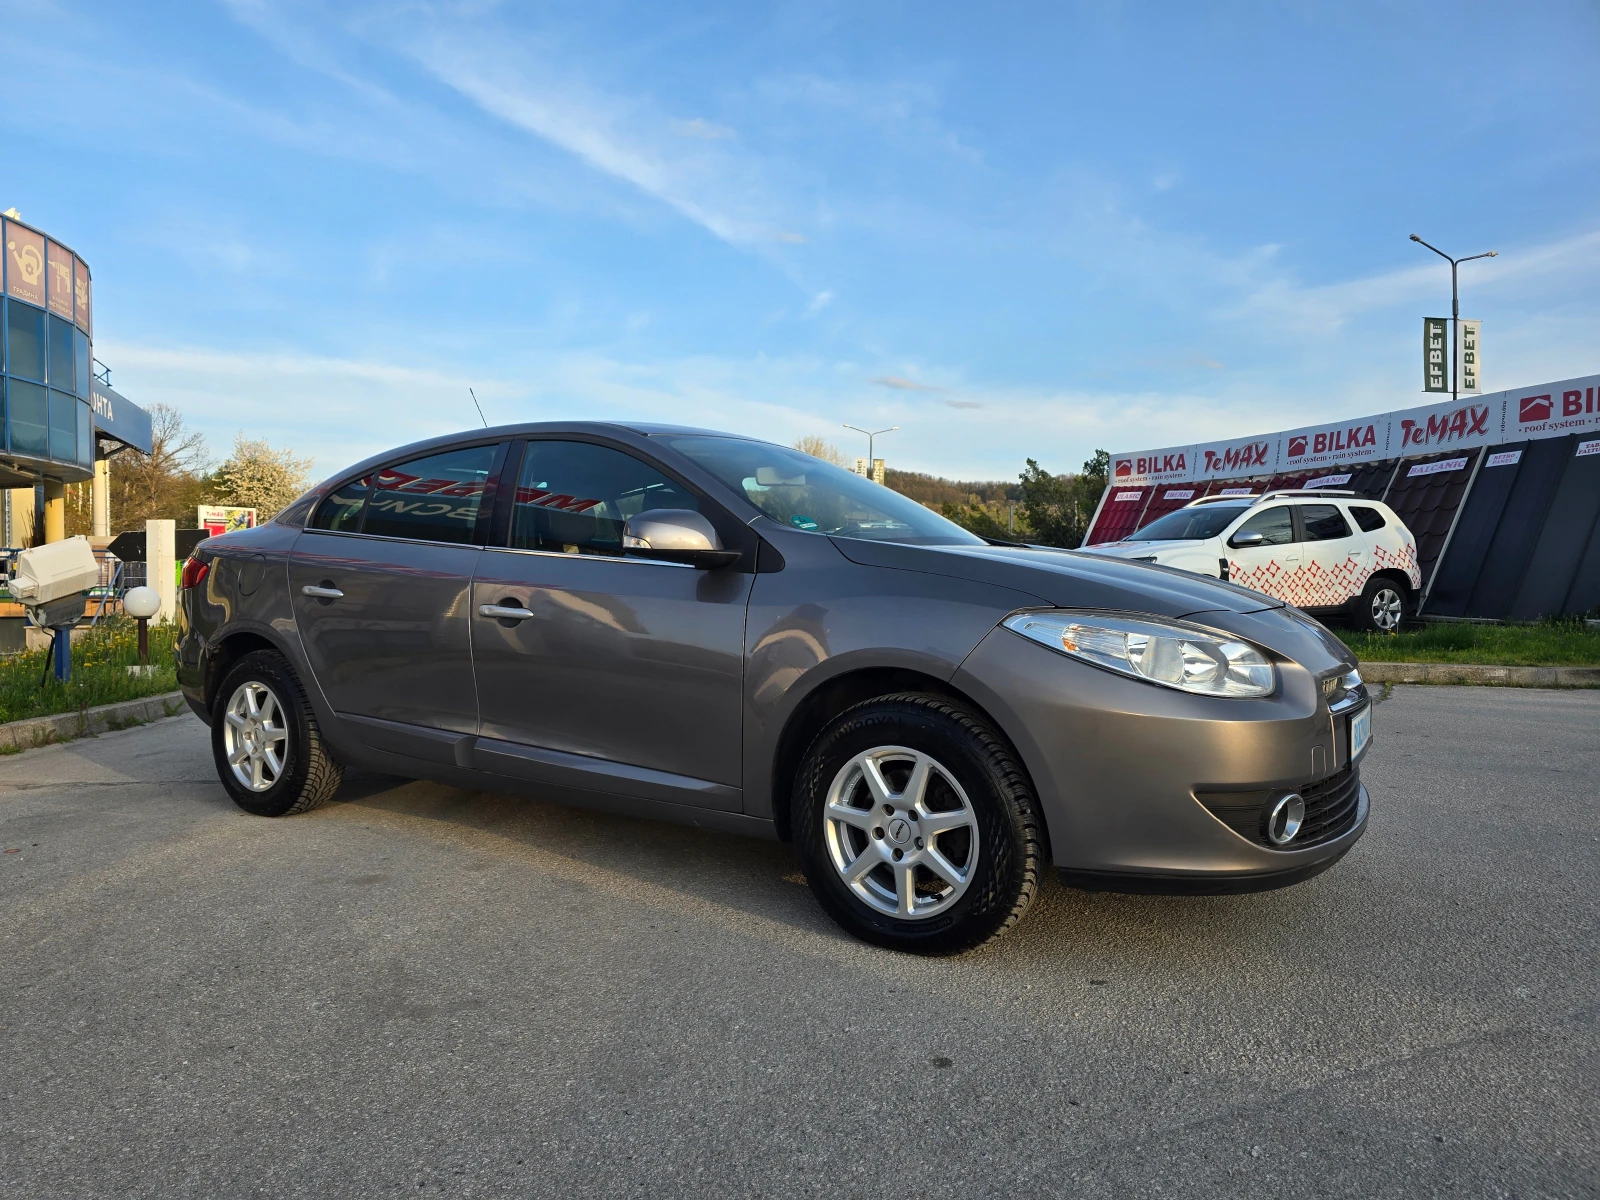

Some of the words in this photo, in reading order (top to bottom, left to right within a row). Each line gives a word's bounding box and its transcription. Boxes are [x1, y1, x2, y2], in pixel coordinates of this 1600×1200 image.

[12, 286, 38, 300] ГРАДИНА
[1430, 322, 1443, 388] EFBET
[1464, 324, 1476, 389] EFBET
[1563, 386, 1600, 417] BI
[1313, 424, 1376, 454] BILKA
[1401, 406, 1490, 449] TeMAX
[1524, 422, 1547, 433] roof
[1548, 419, 1585, 431] system
[1136, 453, 1186, 475] BILKA
[1204, 443, 1269, 474] TeMAX
[1289, 457, 1303, 465] roof
[1303, 455, 1327, 465] system
[1332, 452, 1346, 460] rain
[1347, 449, 1372, 458] system
[1163, 472, 1183, 480] system
[1306, 476, 1348, 488] ROMANIC
